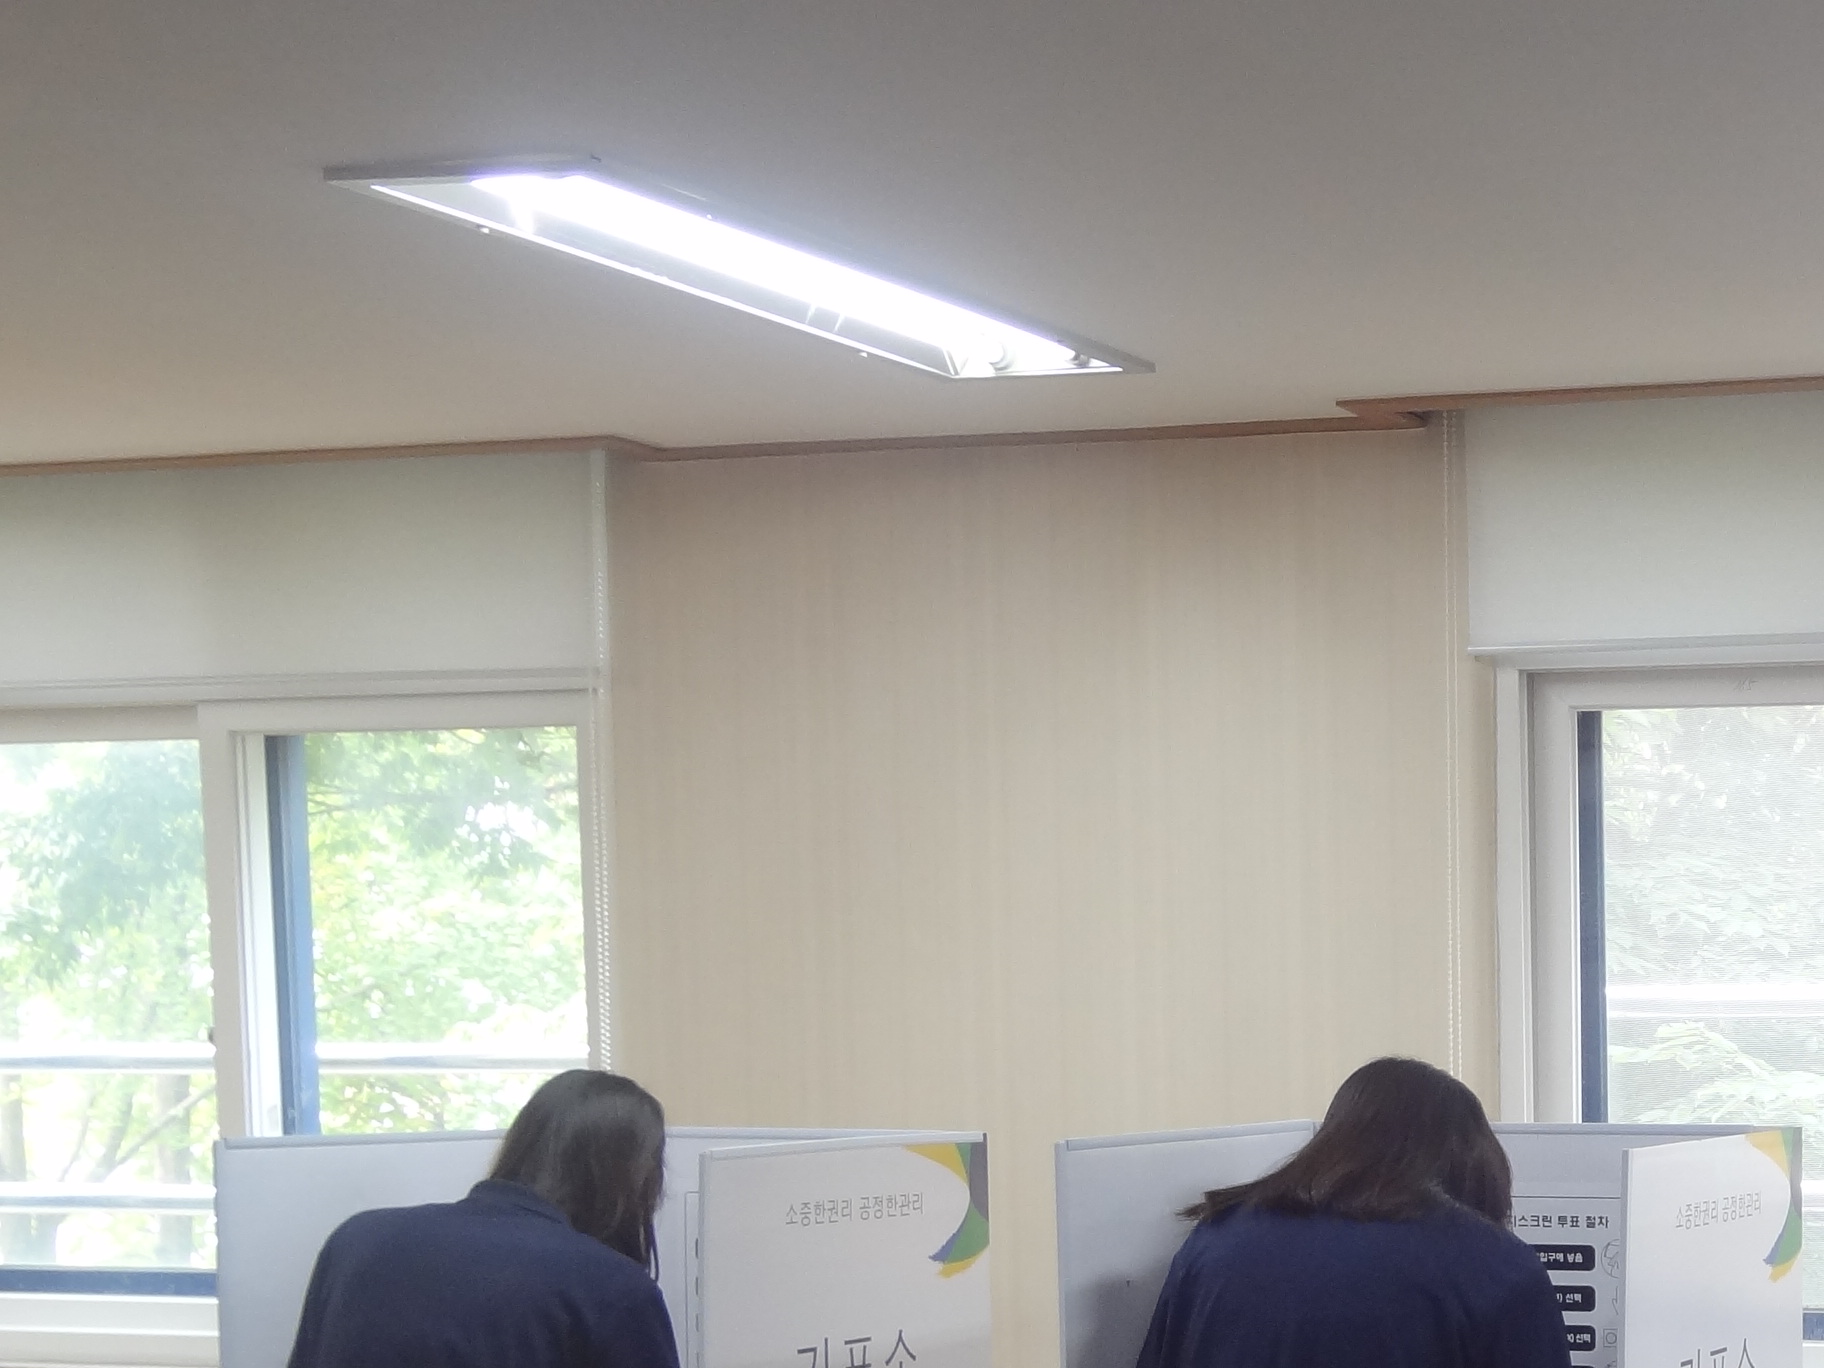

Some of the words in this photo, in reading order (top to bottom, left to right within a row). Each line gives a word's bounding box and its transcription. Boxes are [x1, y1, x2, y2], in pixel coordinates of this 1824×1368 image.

[785, 1198, 852, 1226] 소중한권리
[859, 1191, 923, 1220] 공정한관리
[1675, 1198, 1718, 1229] 소중한권리
[1722, 1190, 1761, 1222] 공정한관리
[1557, 1215, 1580, 1228] 투표
[1585, 1215, 1609, 1229] 절차
[1536, 1252, 1564, 1263] 입구에
[1565, 1293, 1582, 1303] 선택
[1575, 1333, 1591, 1344] 선택
